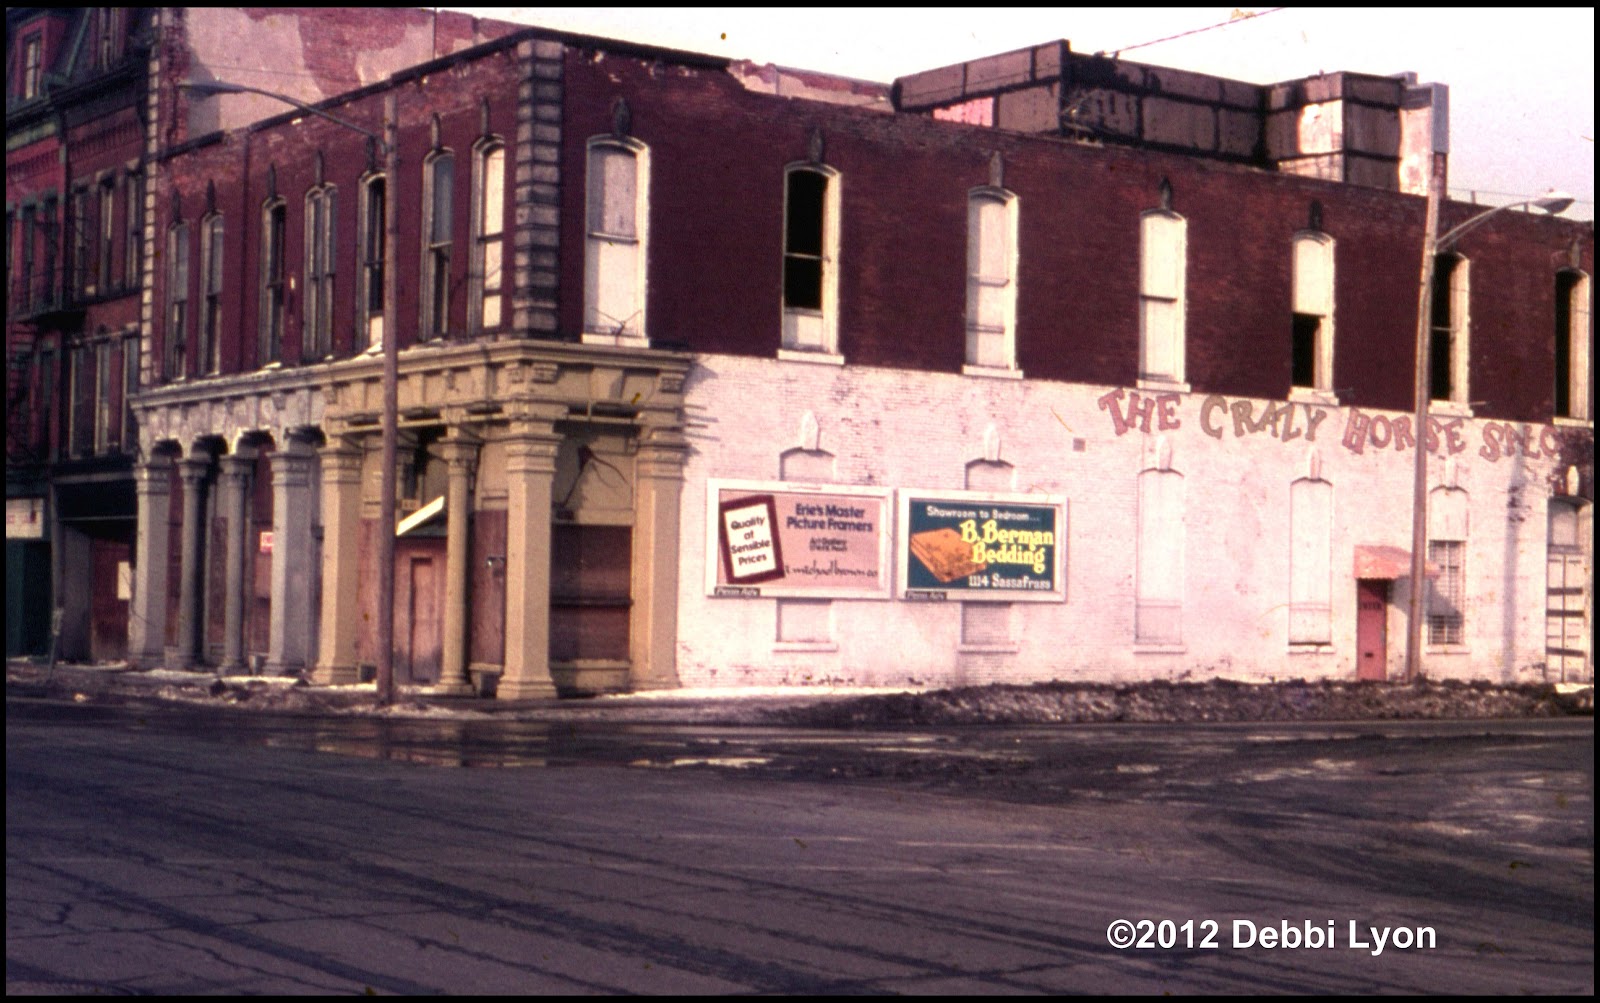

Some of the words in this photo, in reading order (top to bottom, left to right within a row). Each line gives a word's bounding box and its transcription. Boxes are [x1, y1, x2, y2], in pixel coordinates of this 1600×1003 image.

[1098, 388, 1181, 436] THE
[1200, 394, 1327, 442] CRAZY
[1342, 407, 1466, 455] HORSE
[795, 503, 824, 517] Erie's
[825, 505, 865, 518] Master
[926, 505, 977, 519] Showroom
[979, 510, 989, 519] to
[730, 516, 765, 530] Quality
[786, 517, 826, 530] Picture
[827, 518, 873, 532] Framers
[743, 530, 755, 541] at
[730, 539, 771, 554] Sensible
[738, 554, 768, 566] Prices
[971, 541, 1046, 574] Bedding
[968, 575, 990, 587] 1114
